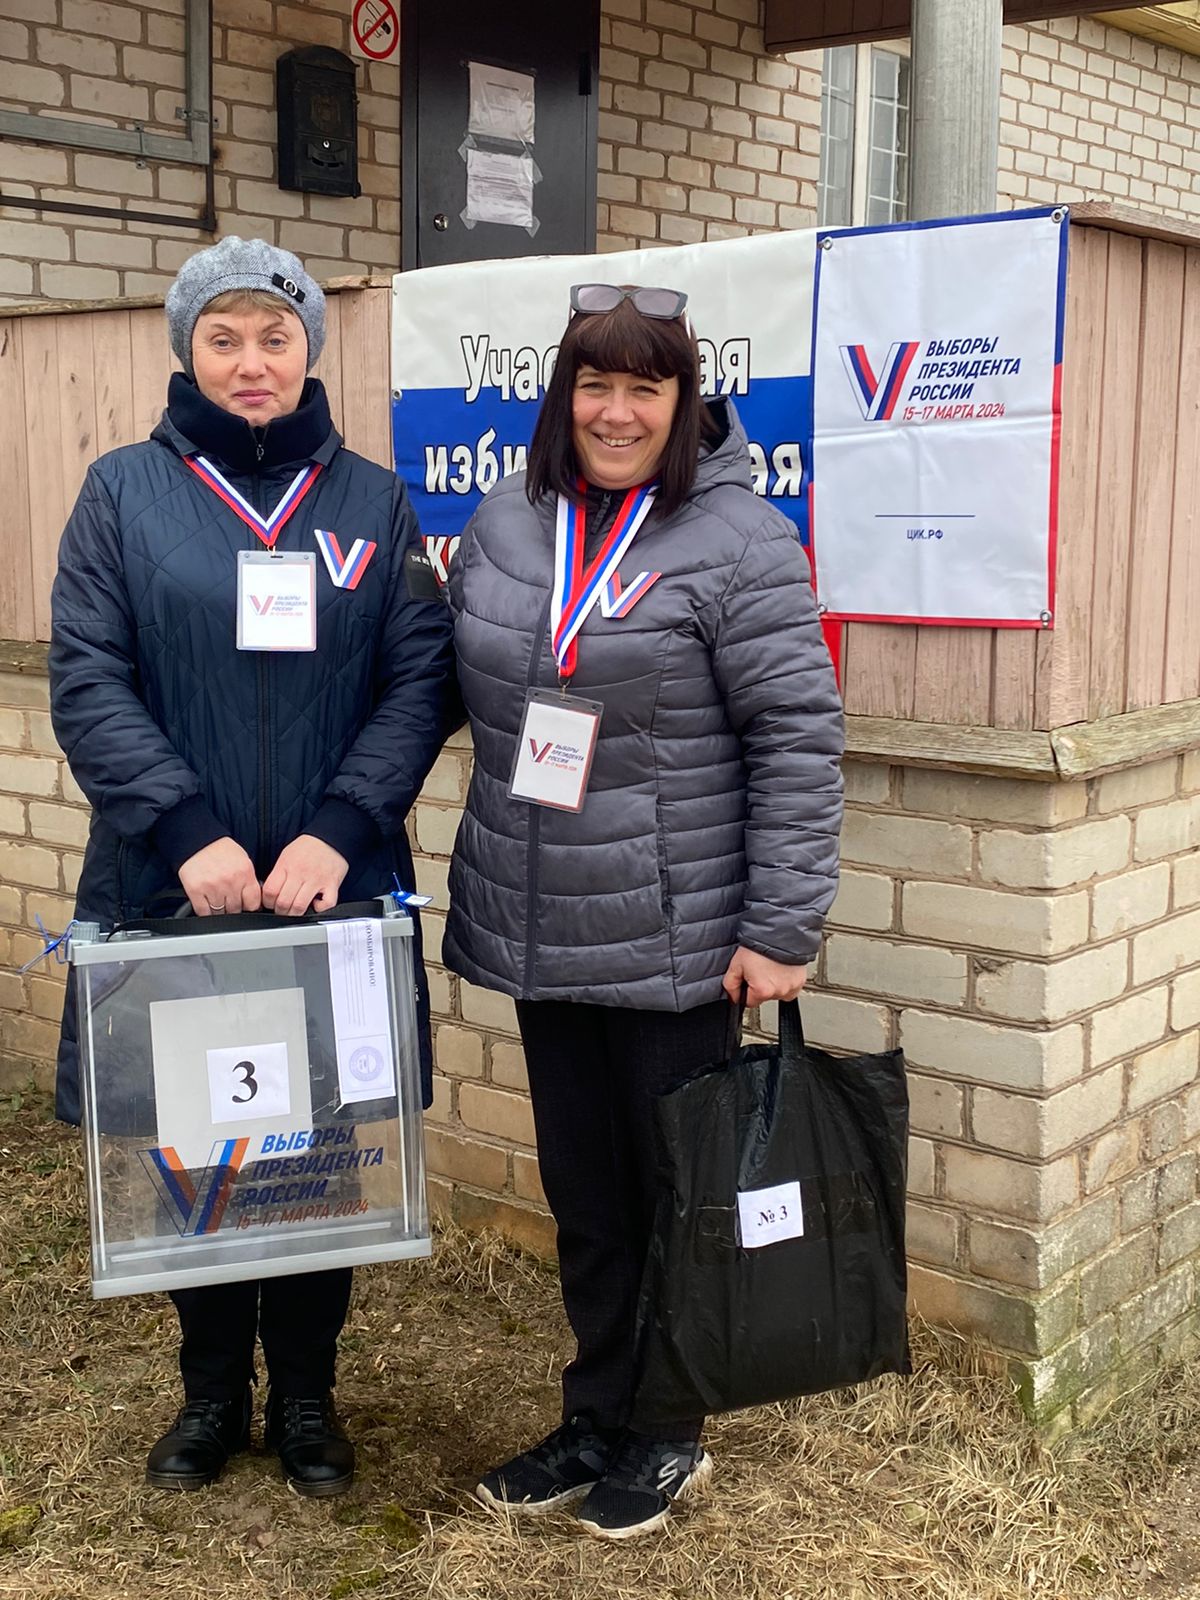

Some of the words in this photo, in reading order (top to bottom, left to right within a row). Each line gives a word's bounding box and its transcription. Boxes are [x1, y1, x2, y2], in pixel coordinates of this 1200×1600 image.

[926, 336, 1000, 357] ВЫБОРЫ
[917, 358, 1021, 379] ПРЕЗИДЕНТА
[908, 382, 975, 401] РОССИИ
[934, 404, 974, 420] МАРТА
[975, 403, 1006, 418] 2024
[906, 529, 944, 541] ЦИК.РФ
[231, 1060, 259, 1104] 3
[260, 1126, 355, 1154] ВЫБОРЫ
[251, 1147, 384, 1180] ПРЕЗИДЕНТА
[242, 1179, 329, 1208] РОССИИ
[278, 1206, 331, 1226] МАРТА
[331, 1198, 370, 1219] 2024
[757, 1209, 776, 1227] №
[779, 1205, 788, 1221] 3
